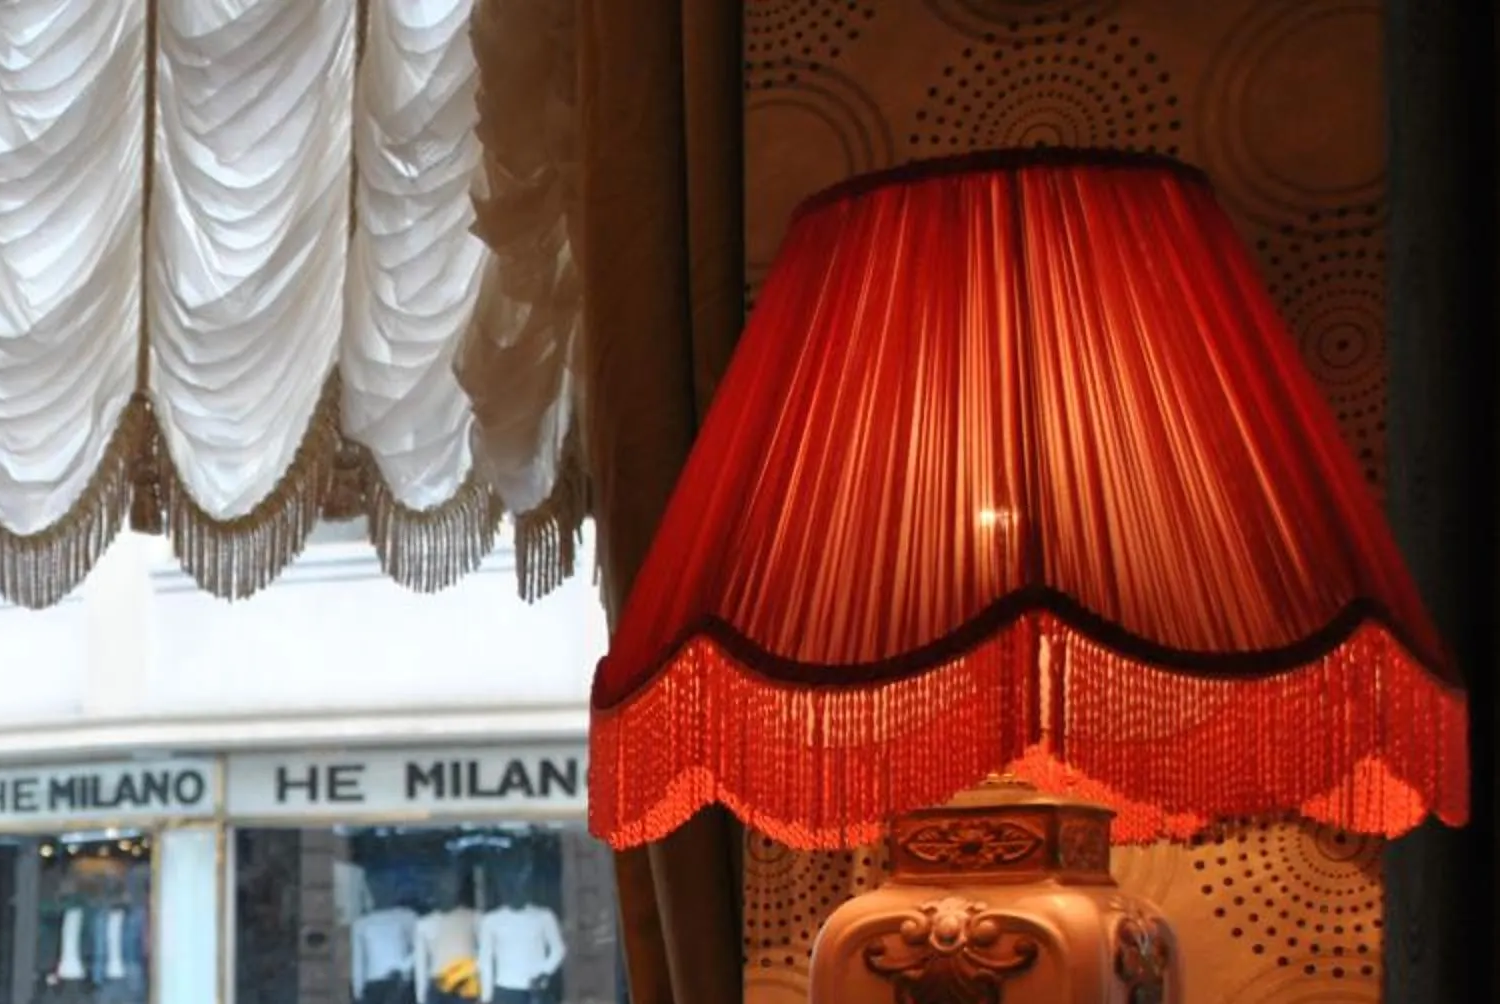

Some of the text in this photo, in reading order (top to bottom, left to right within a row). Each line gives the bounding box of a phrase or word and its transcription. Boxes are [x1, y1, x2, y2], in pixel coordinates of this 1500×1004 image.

[49, 770, 205, 811] MILANO
[276, 757, 588, 804] HE MILAN
